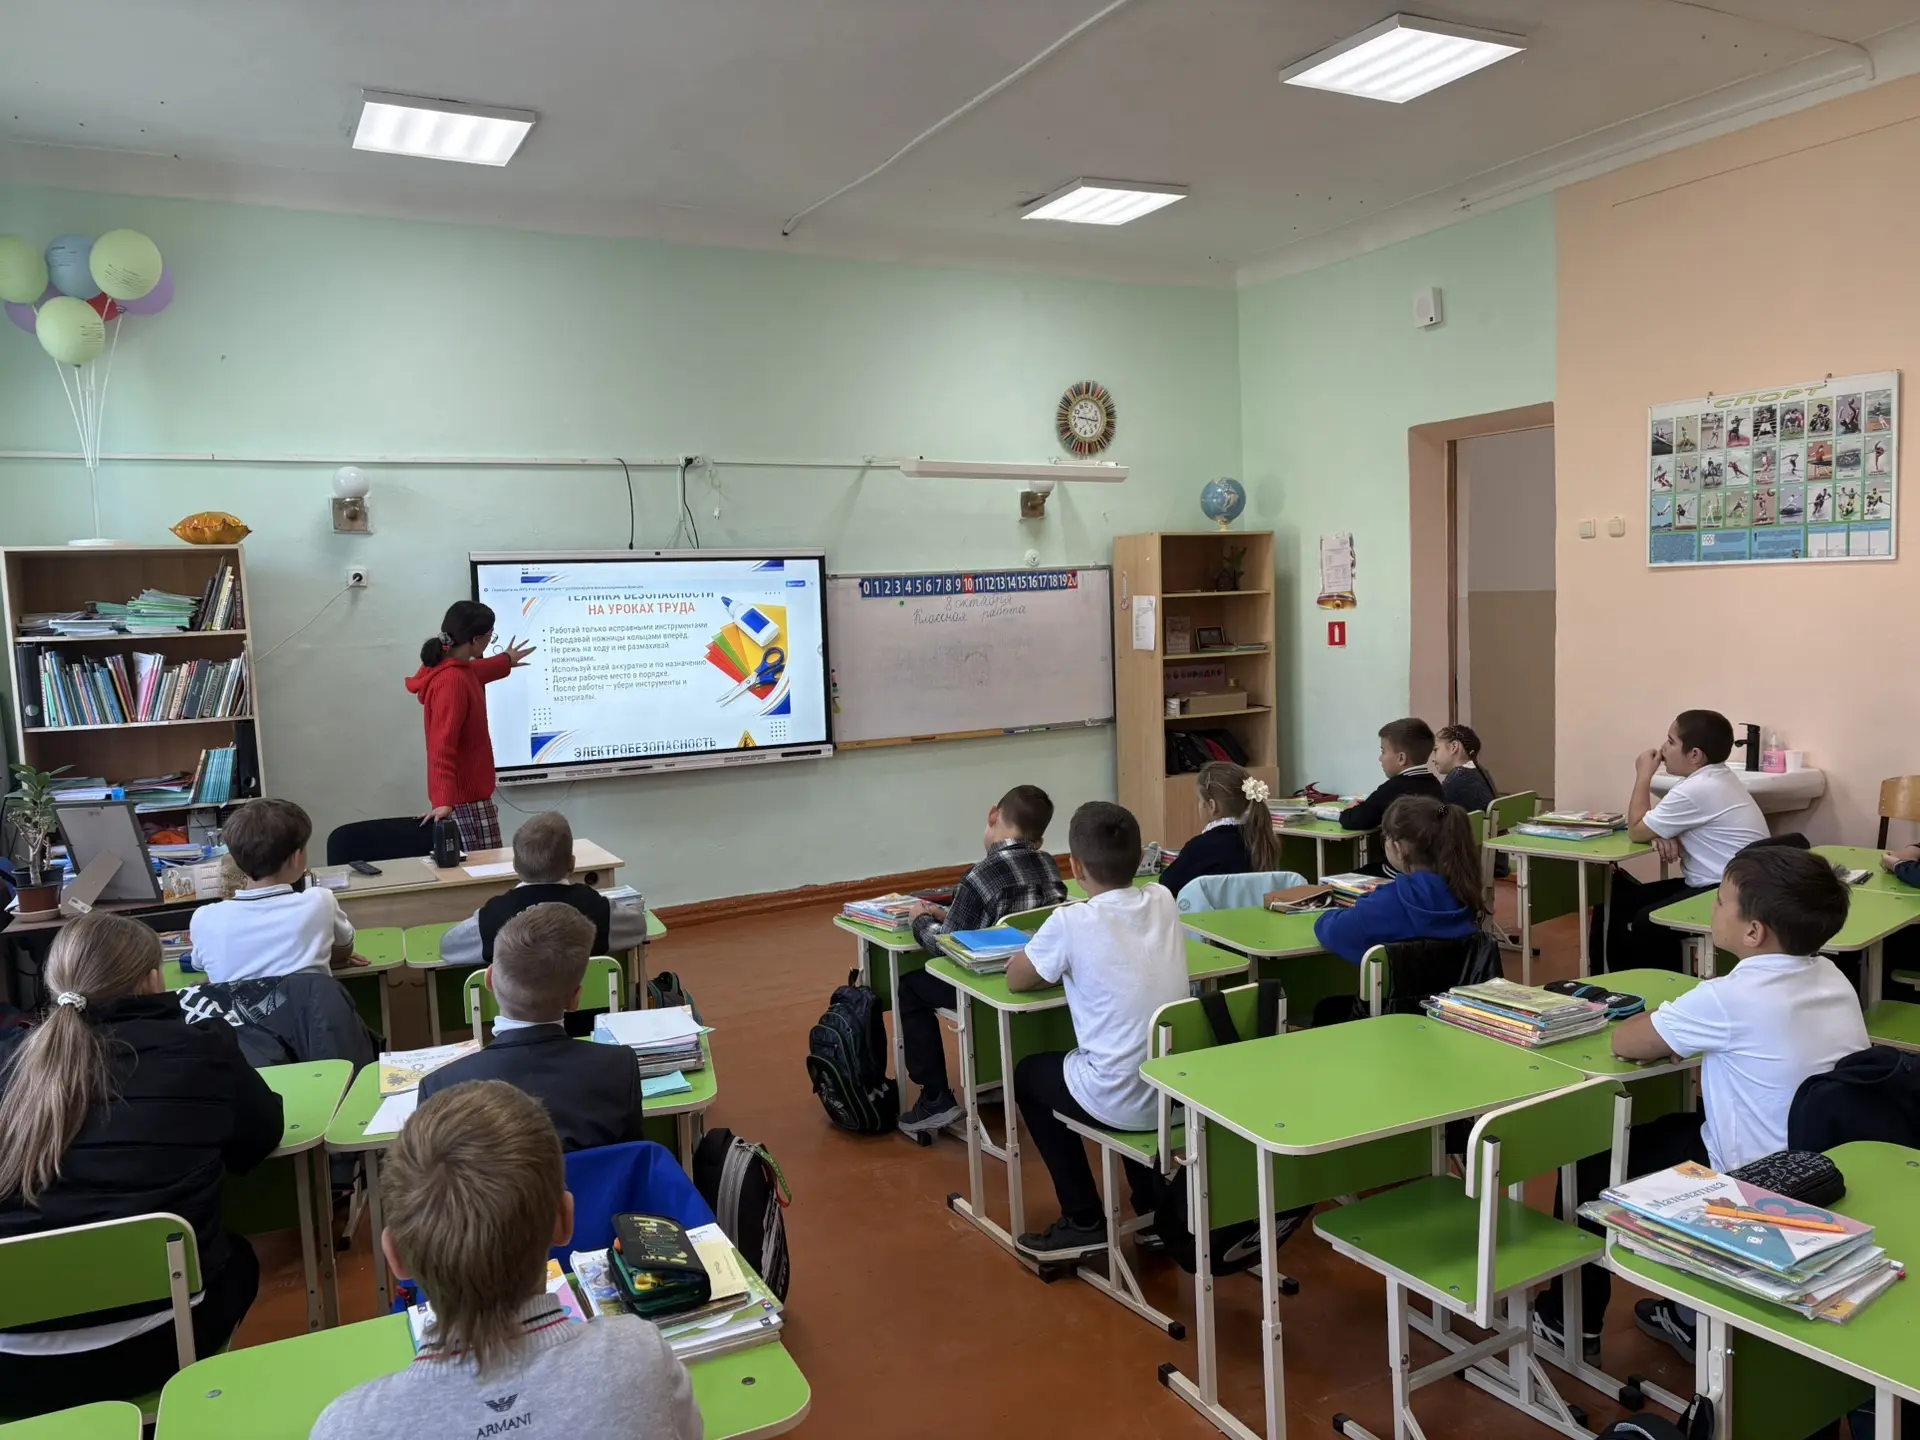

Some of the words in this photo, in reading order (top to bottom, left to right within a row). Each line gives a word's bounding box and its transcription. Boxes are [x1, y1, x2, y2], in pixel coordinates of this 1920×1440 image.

[1714, 385, 1827, 408] СПОРТ
[864, 581, 870, 594] 0
[874, 581, 880, 594] 1
[884, 581, 890, 594] 2
[895, 581, 900, 593] 3
[905, 580, 912, 593] 4
[916, 580, 922, 592] 5
[926, 580, 932, 592] 6
[936, 579, 942, 592] 7
[946, 579, 952, 591] 8
[956, 578, 961, 591] 9
[964, 578, 972, 590] 10
[976, 578, 982, 590] 11
[986, 577, 994, 590] 12
[996, 577, 1005, 589] 13
[1007, 576, 1016, 588] 14
[1018, 576, 1026, 588] 15
[1028, 576, 1037, 588] 16
[1038, 576, 1047, 587] 17
[1048, 575, 1057, 586] 18
[1059, 575, 1066, 586] 19
[588, 604, 604, 615] НА
[608, 602, 654, 614] УРОКАХ
[657, 601, 696, 614] ТРУДА
[982, 605, 1026, 622] работа
[550, 626, 580, 634] Работай
[550, 636, 590, 644] Передавай
[563, 646, 581, 654] режь
[628, 642, 669, 652] размахивай
[552, 664, 591, 672] Используй
[612, 662, 647, 670] аккуратно
[580, 674, 608, 682] рабочее
[639, 671, 670, 679] порядке.
[578, 683, 604, 692] работы
[613, 682, 634, 690] убери
[635, 680, 680, 688] инструменты
[574, 737, 717, 758] ЭЛЕКТРОБЕЗОПАСНОСТЬ
[1645, 1182, 1728, 1210] Математика
[477, 1412, 532, 1440] ARMANI
